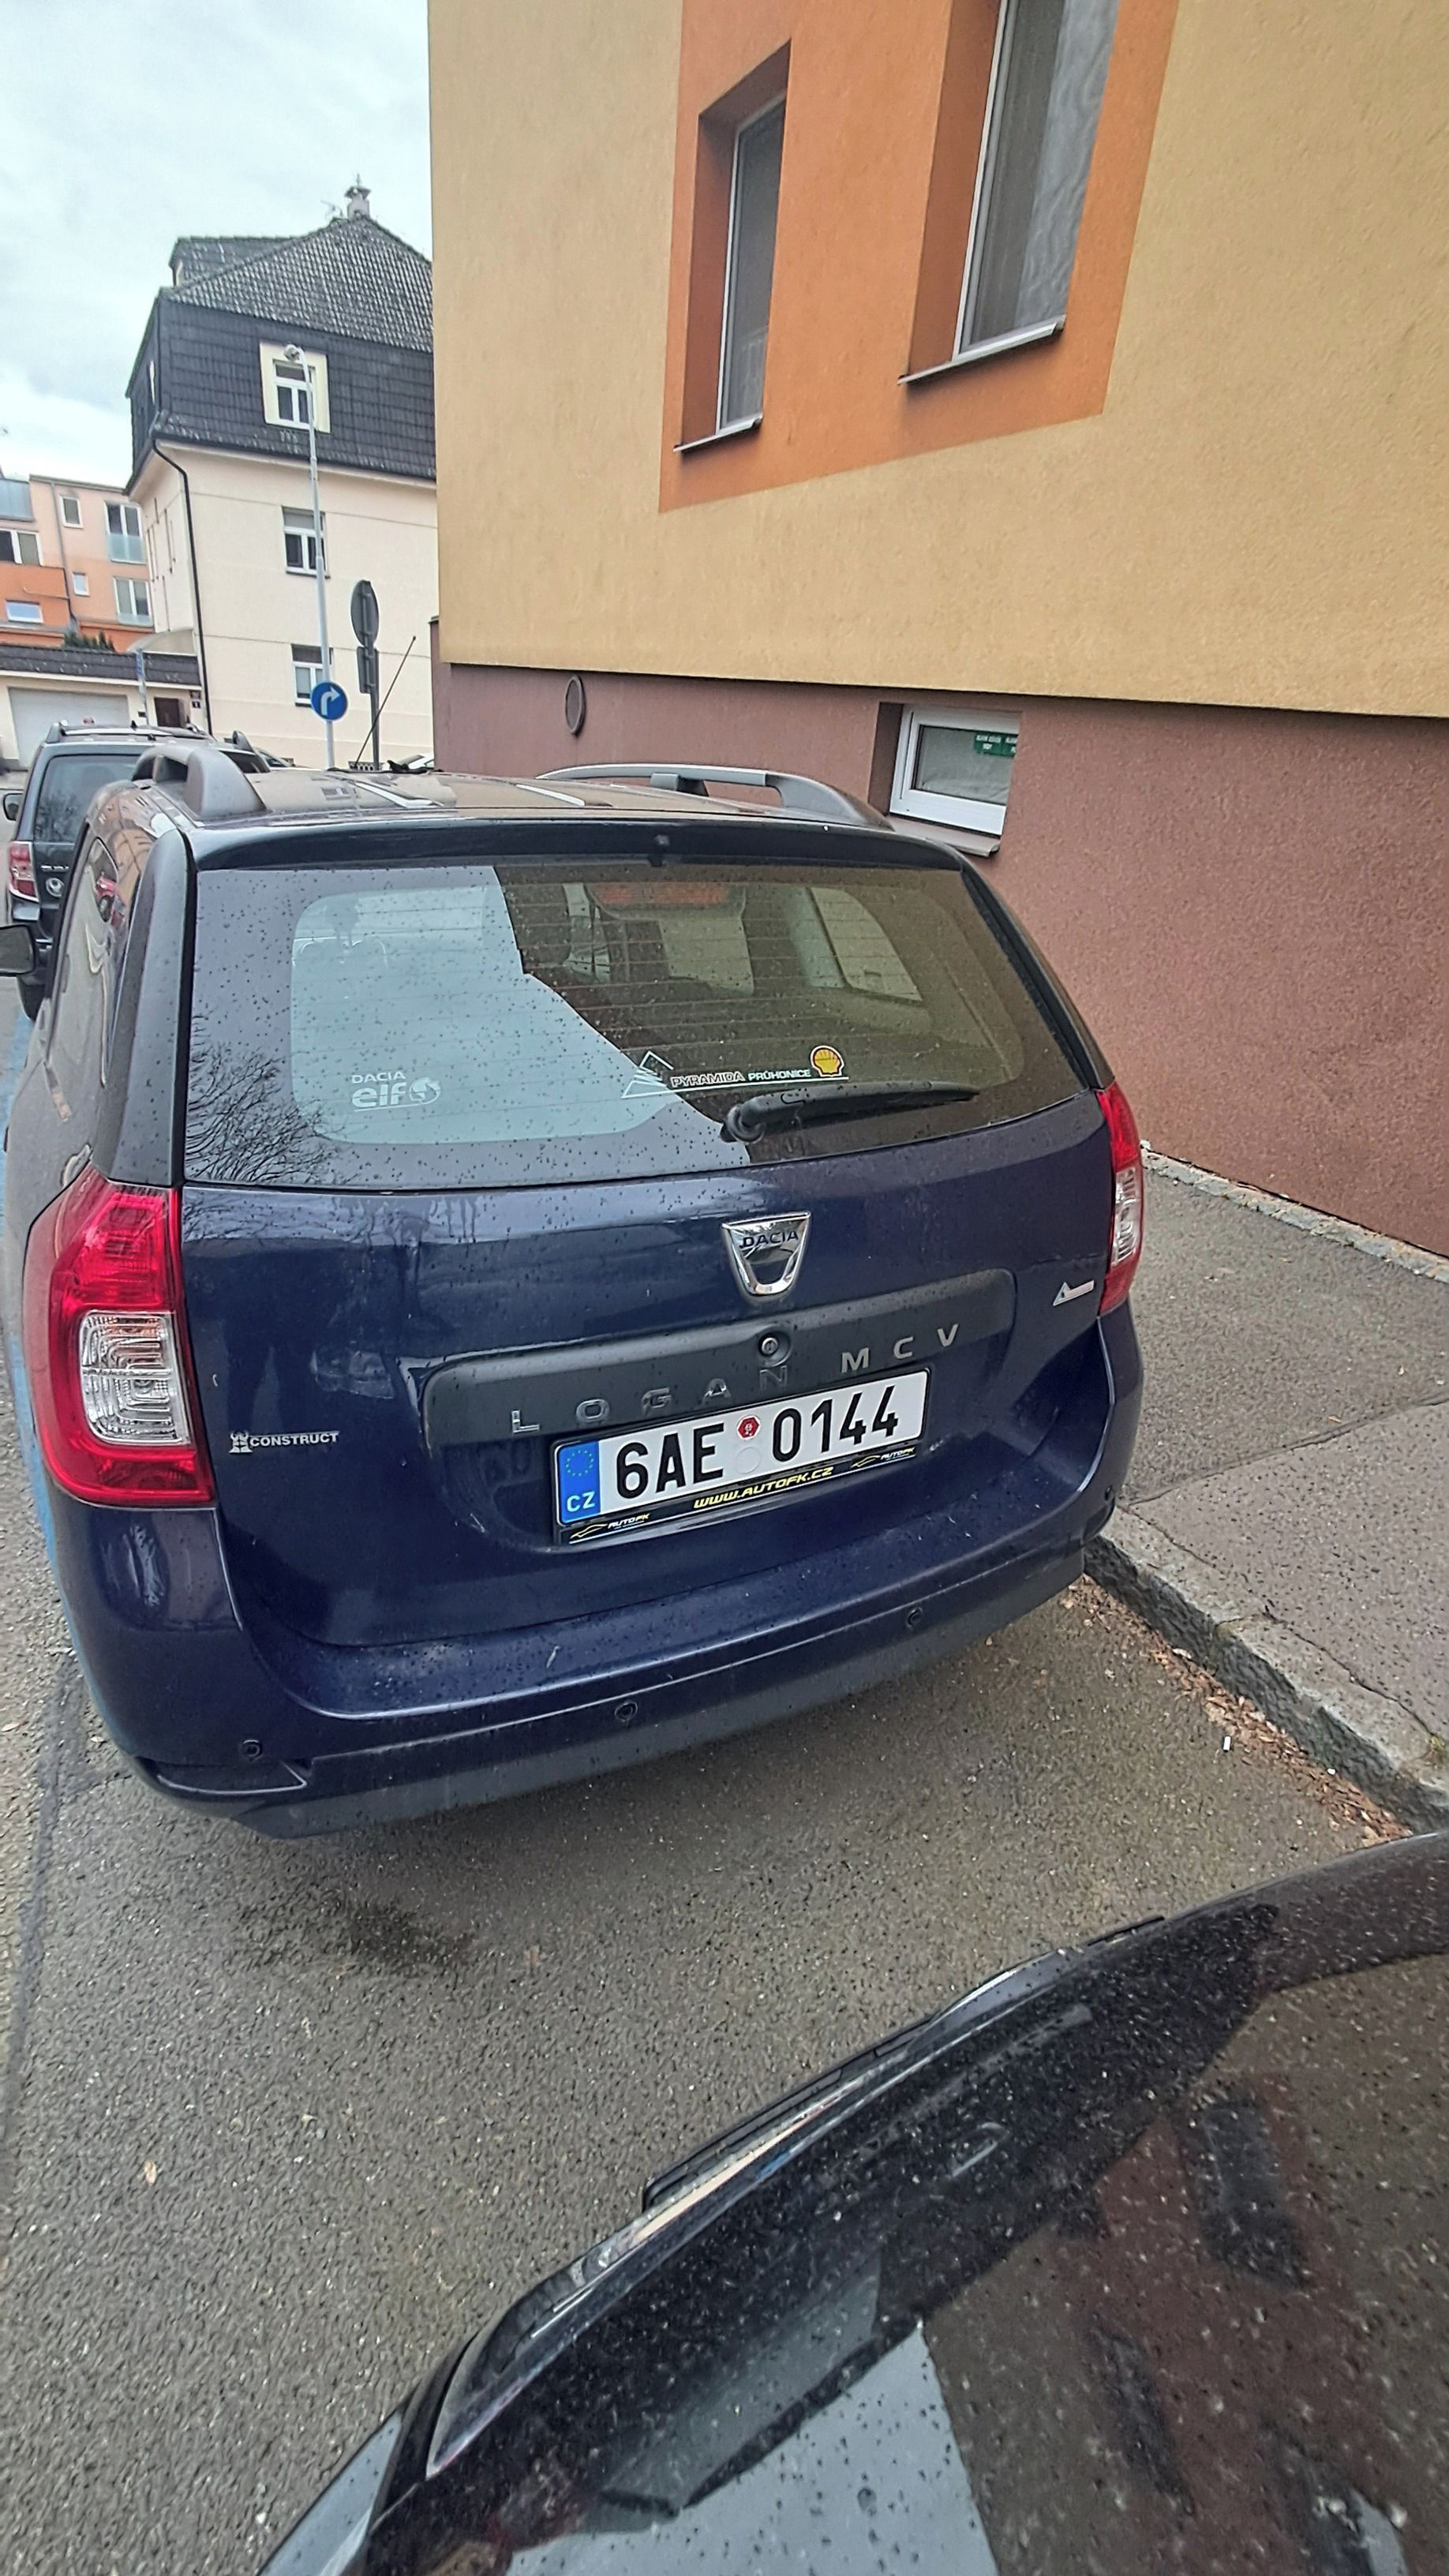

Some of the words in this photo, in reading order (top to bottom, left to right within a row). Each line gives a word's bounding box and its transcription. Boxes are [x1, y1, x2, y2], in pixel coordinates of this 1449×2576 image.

[352, 1071, 406, 1084] DACIA
[671, 1071, 745, 1088] PYRAMIDA
[352, 1082, 406, 1107] elf
[742, 1230, 799, 1248] DACIA
[511, 1365, 788, 1433] LOGAN
[841, 1323, 960, 1373] MCV
[249, 1432, 339, 1447] CONSTRUCT
[616, 1423, 724, 1500] 6AE
[772, 1385, 899, 1462] 0144
[567, 1491, 595, 1512] CZ
